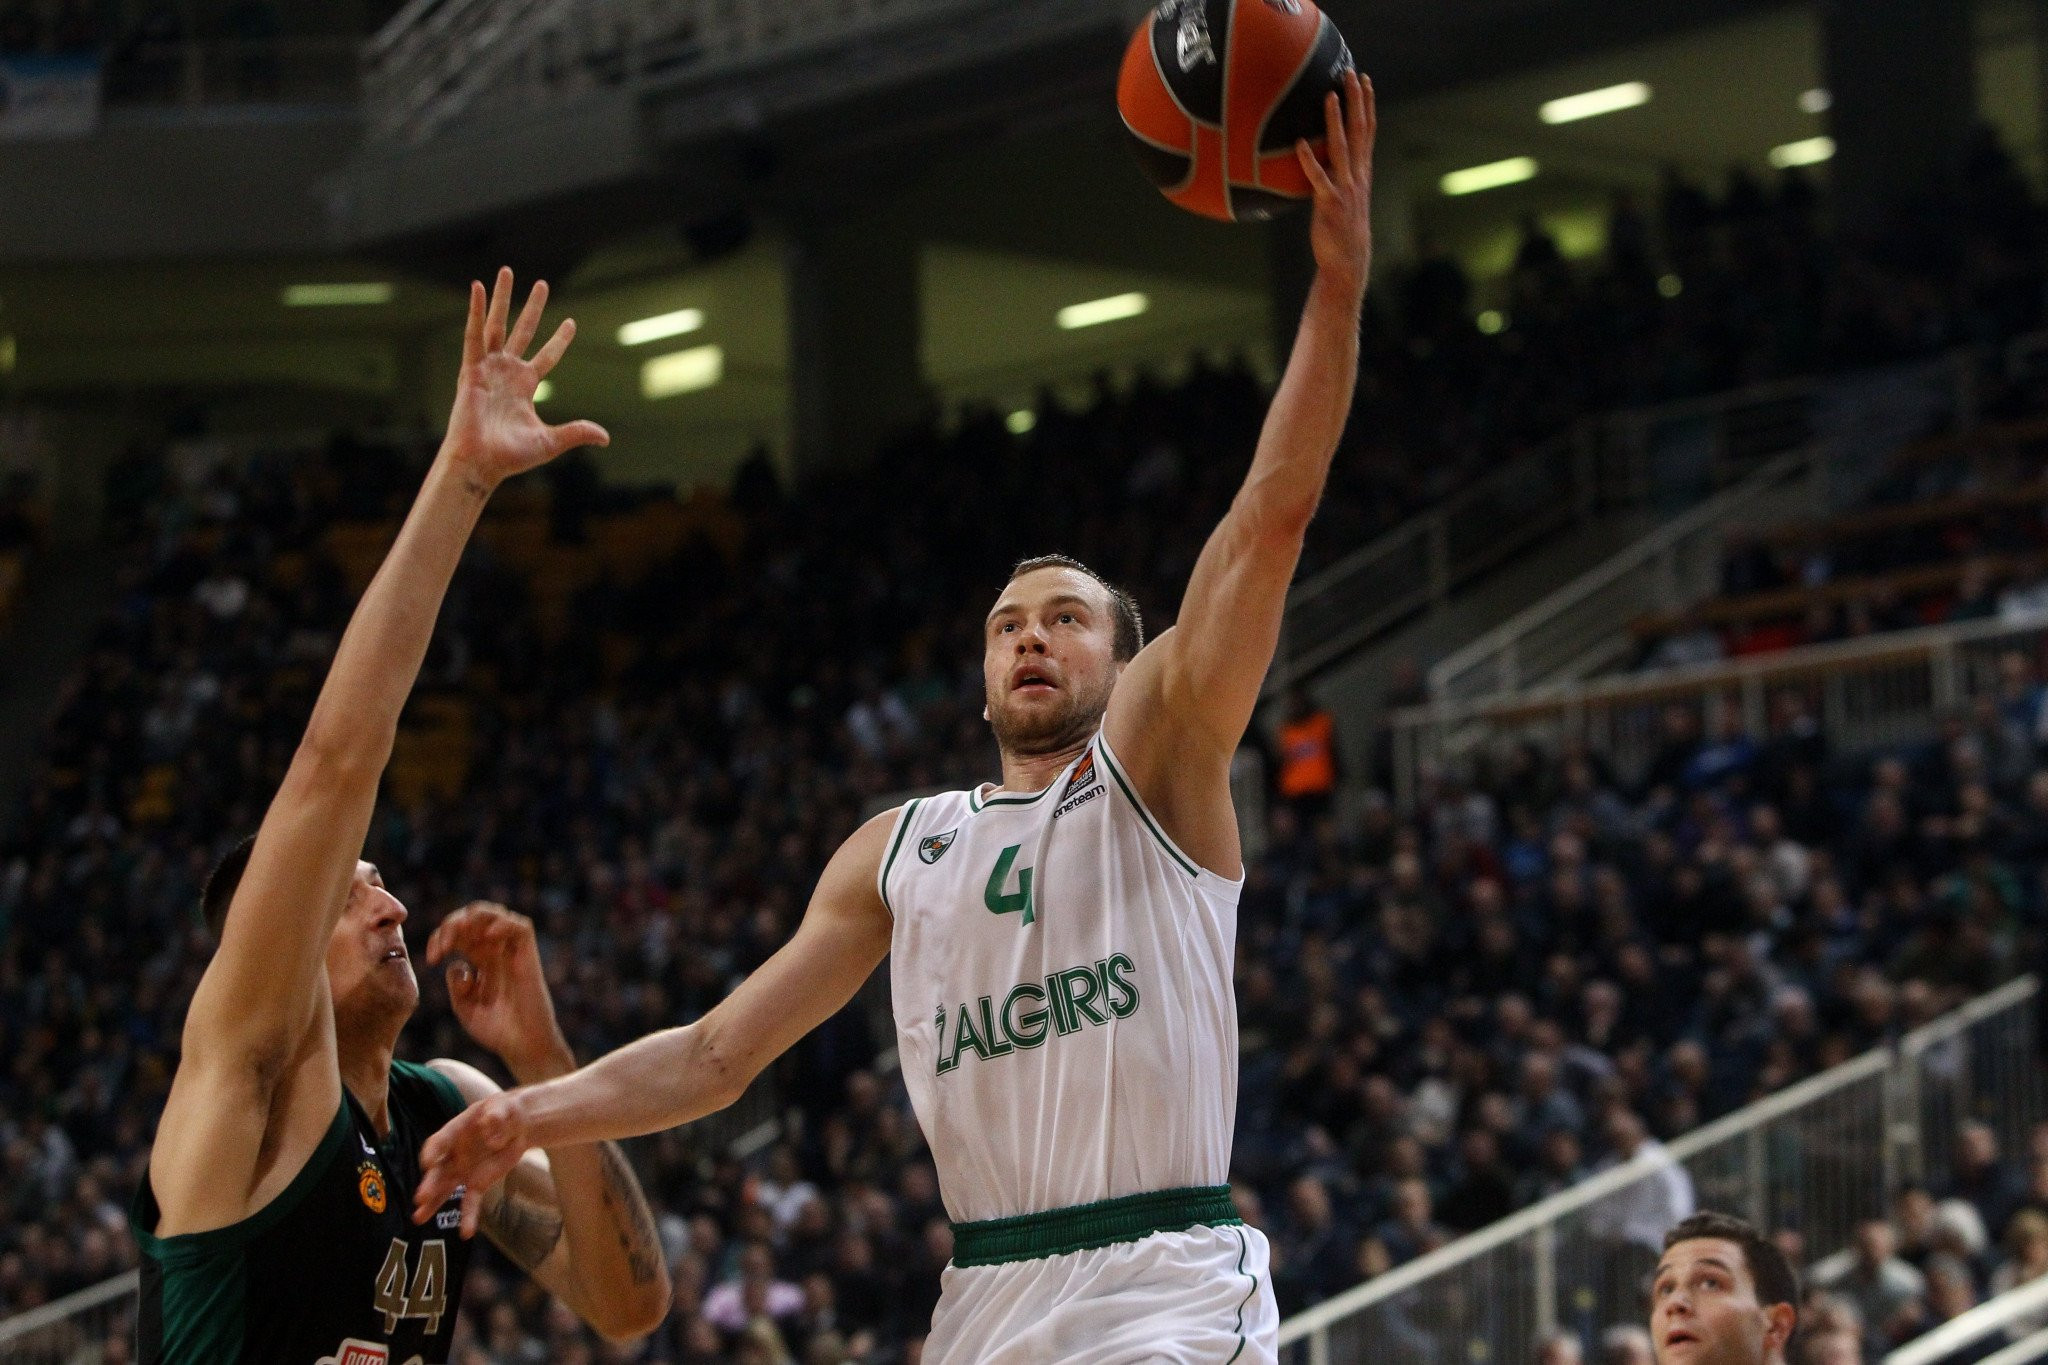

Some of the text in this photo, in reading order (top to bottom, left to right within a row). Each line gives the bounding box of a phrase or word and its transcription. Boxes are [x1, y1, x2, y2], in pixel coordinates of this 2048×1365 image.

[1053, 784, 1106, 819] oneteam
[984, 844, 1035, 928] 4
[935, 953, 1140, 1077] ŽALGIRIS
[373, 1237, 447, 1335] 44
